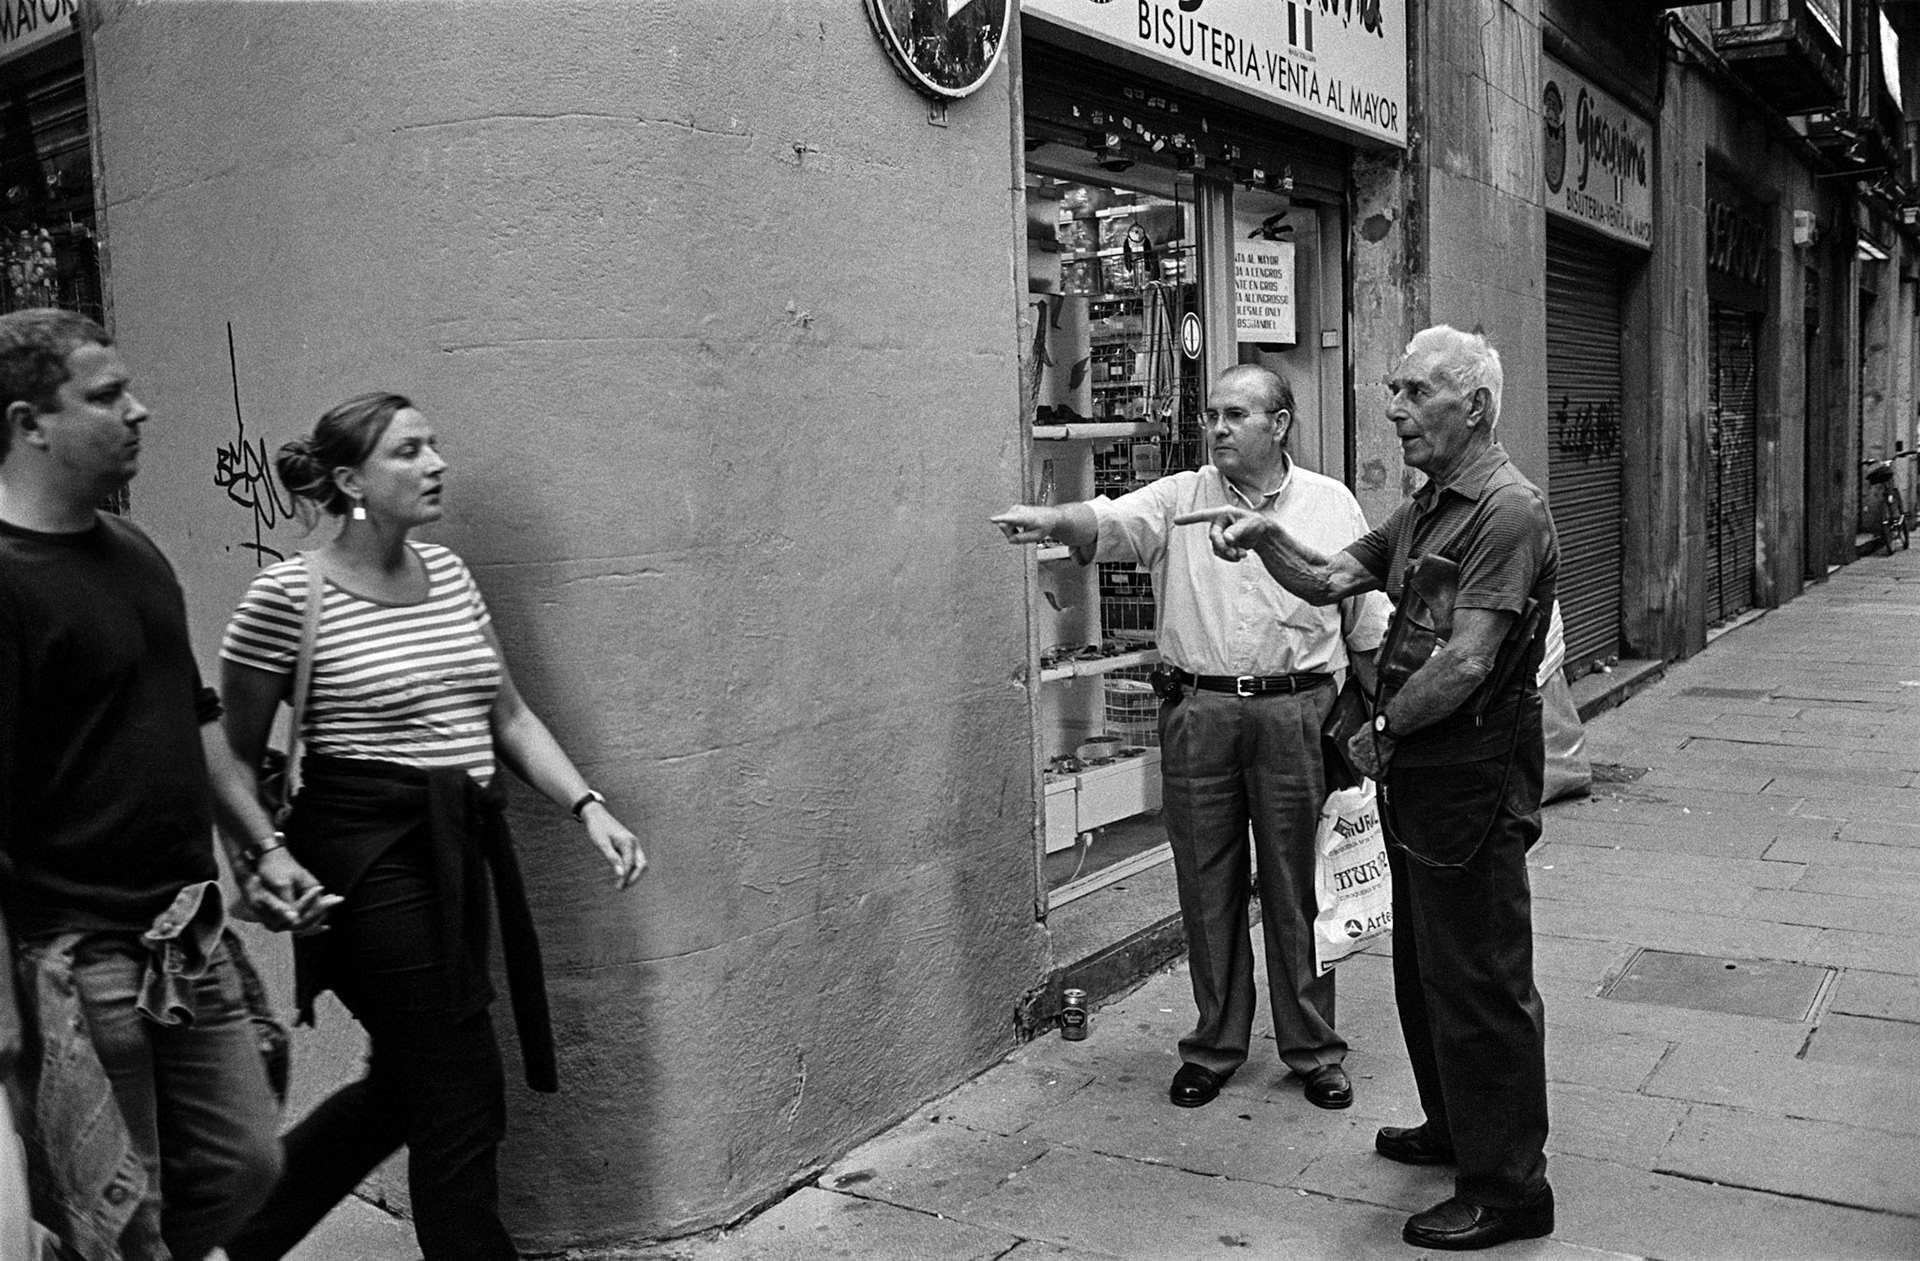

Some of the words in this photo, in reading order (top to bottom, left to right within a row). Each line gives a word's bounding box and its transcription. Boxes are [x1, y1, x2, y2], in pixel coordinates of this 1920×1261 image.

[1326, 76, 1345, 113] AL
[1349, 85, 1398, 133] MAYOR
[1257, 254, 1279, 265] MAYOR
[1264, 307, 1281, 317] ONLY
